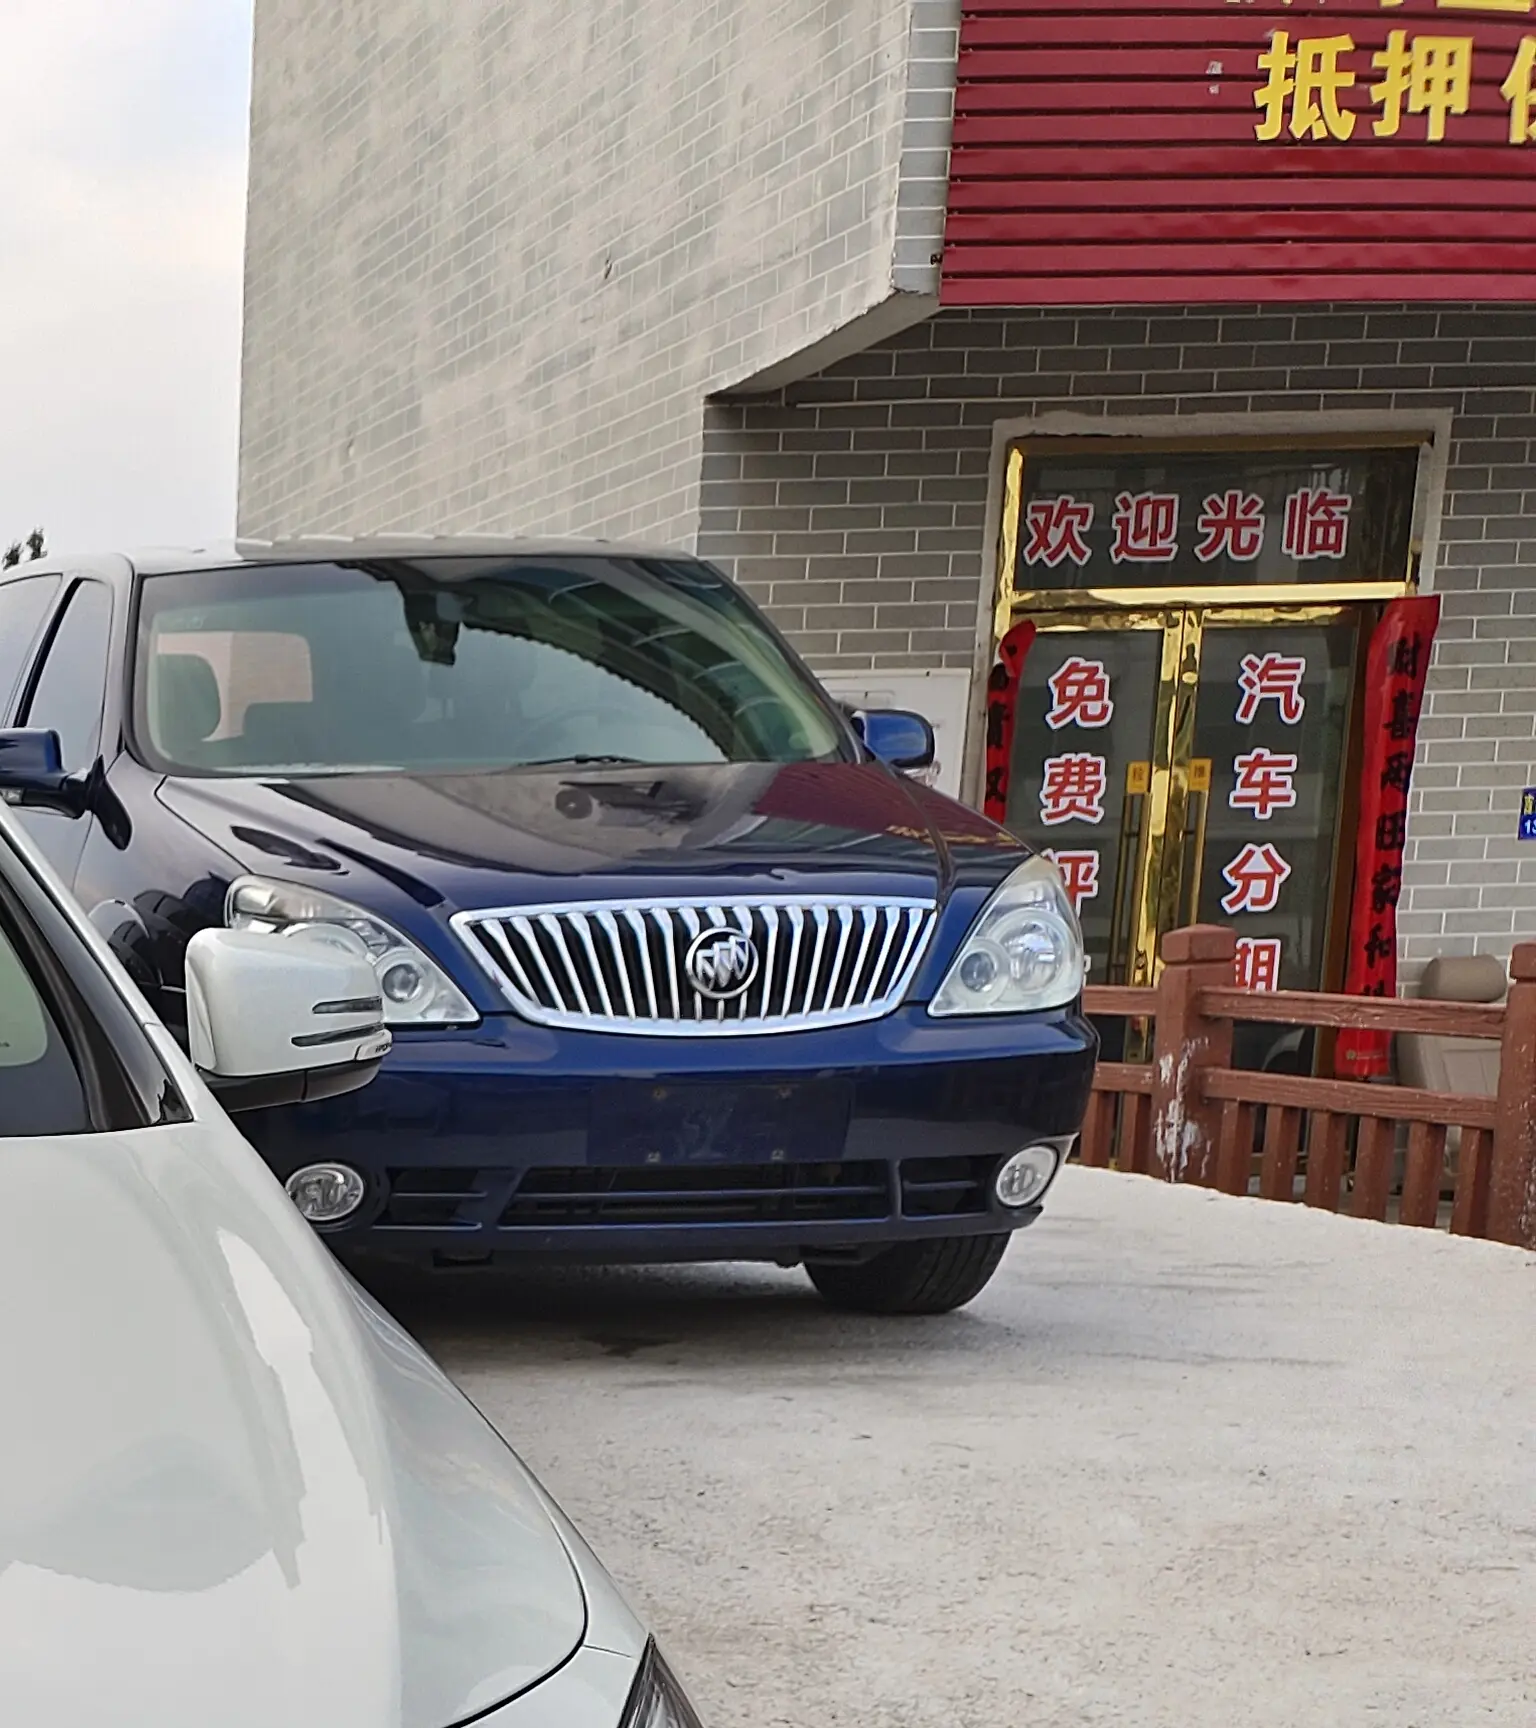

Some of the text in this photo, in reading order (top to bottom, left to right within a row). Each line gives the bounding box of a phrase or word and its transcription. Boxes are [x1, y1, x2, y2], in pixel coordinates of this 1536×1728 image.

[1254, 29, 1536, 144] 抵押
[1024, 489, 1351, 568] 欢迎光临
[1039, 657, 1113, 988] 免费评
